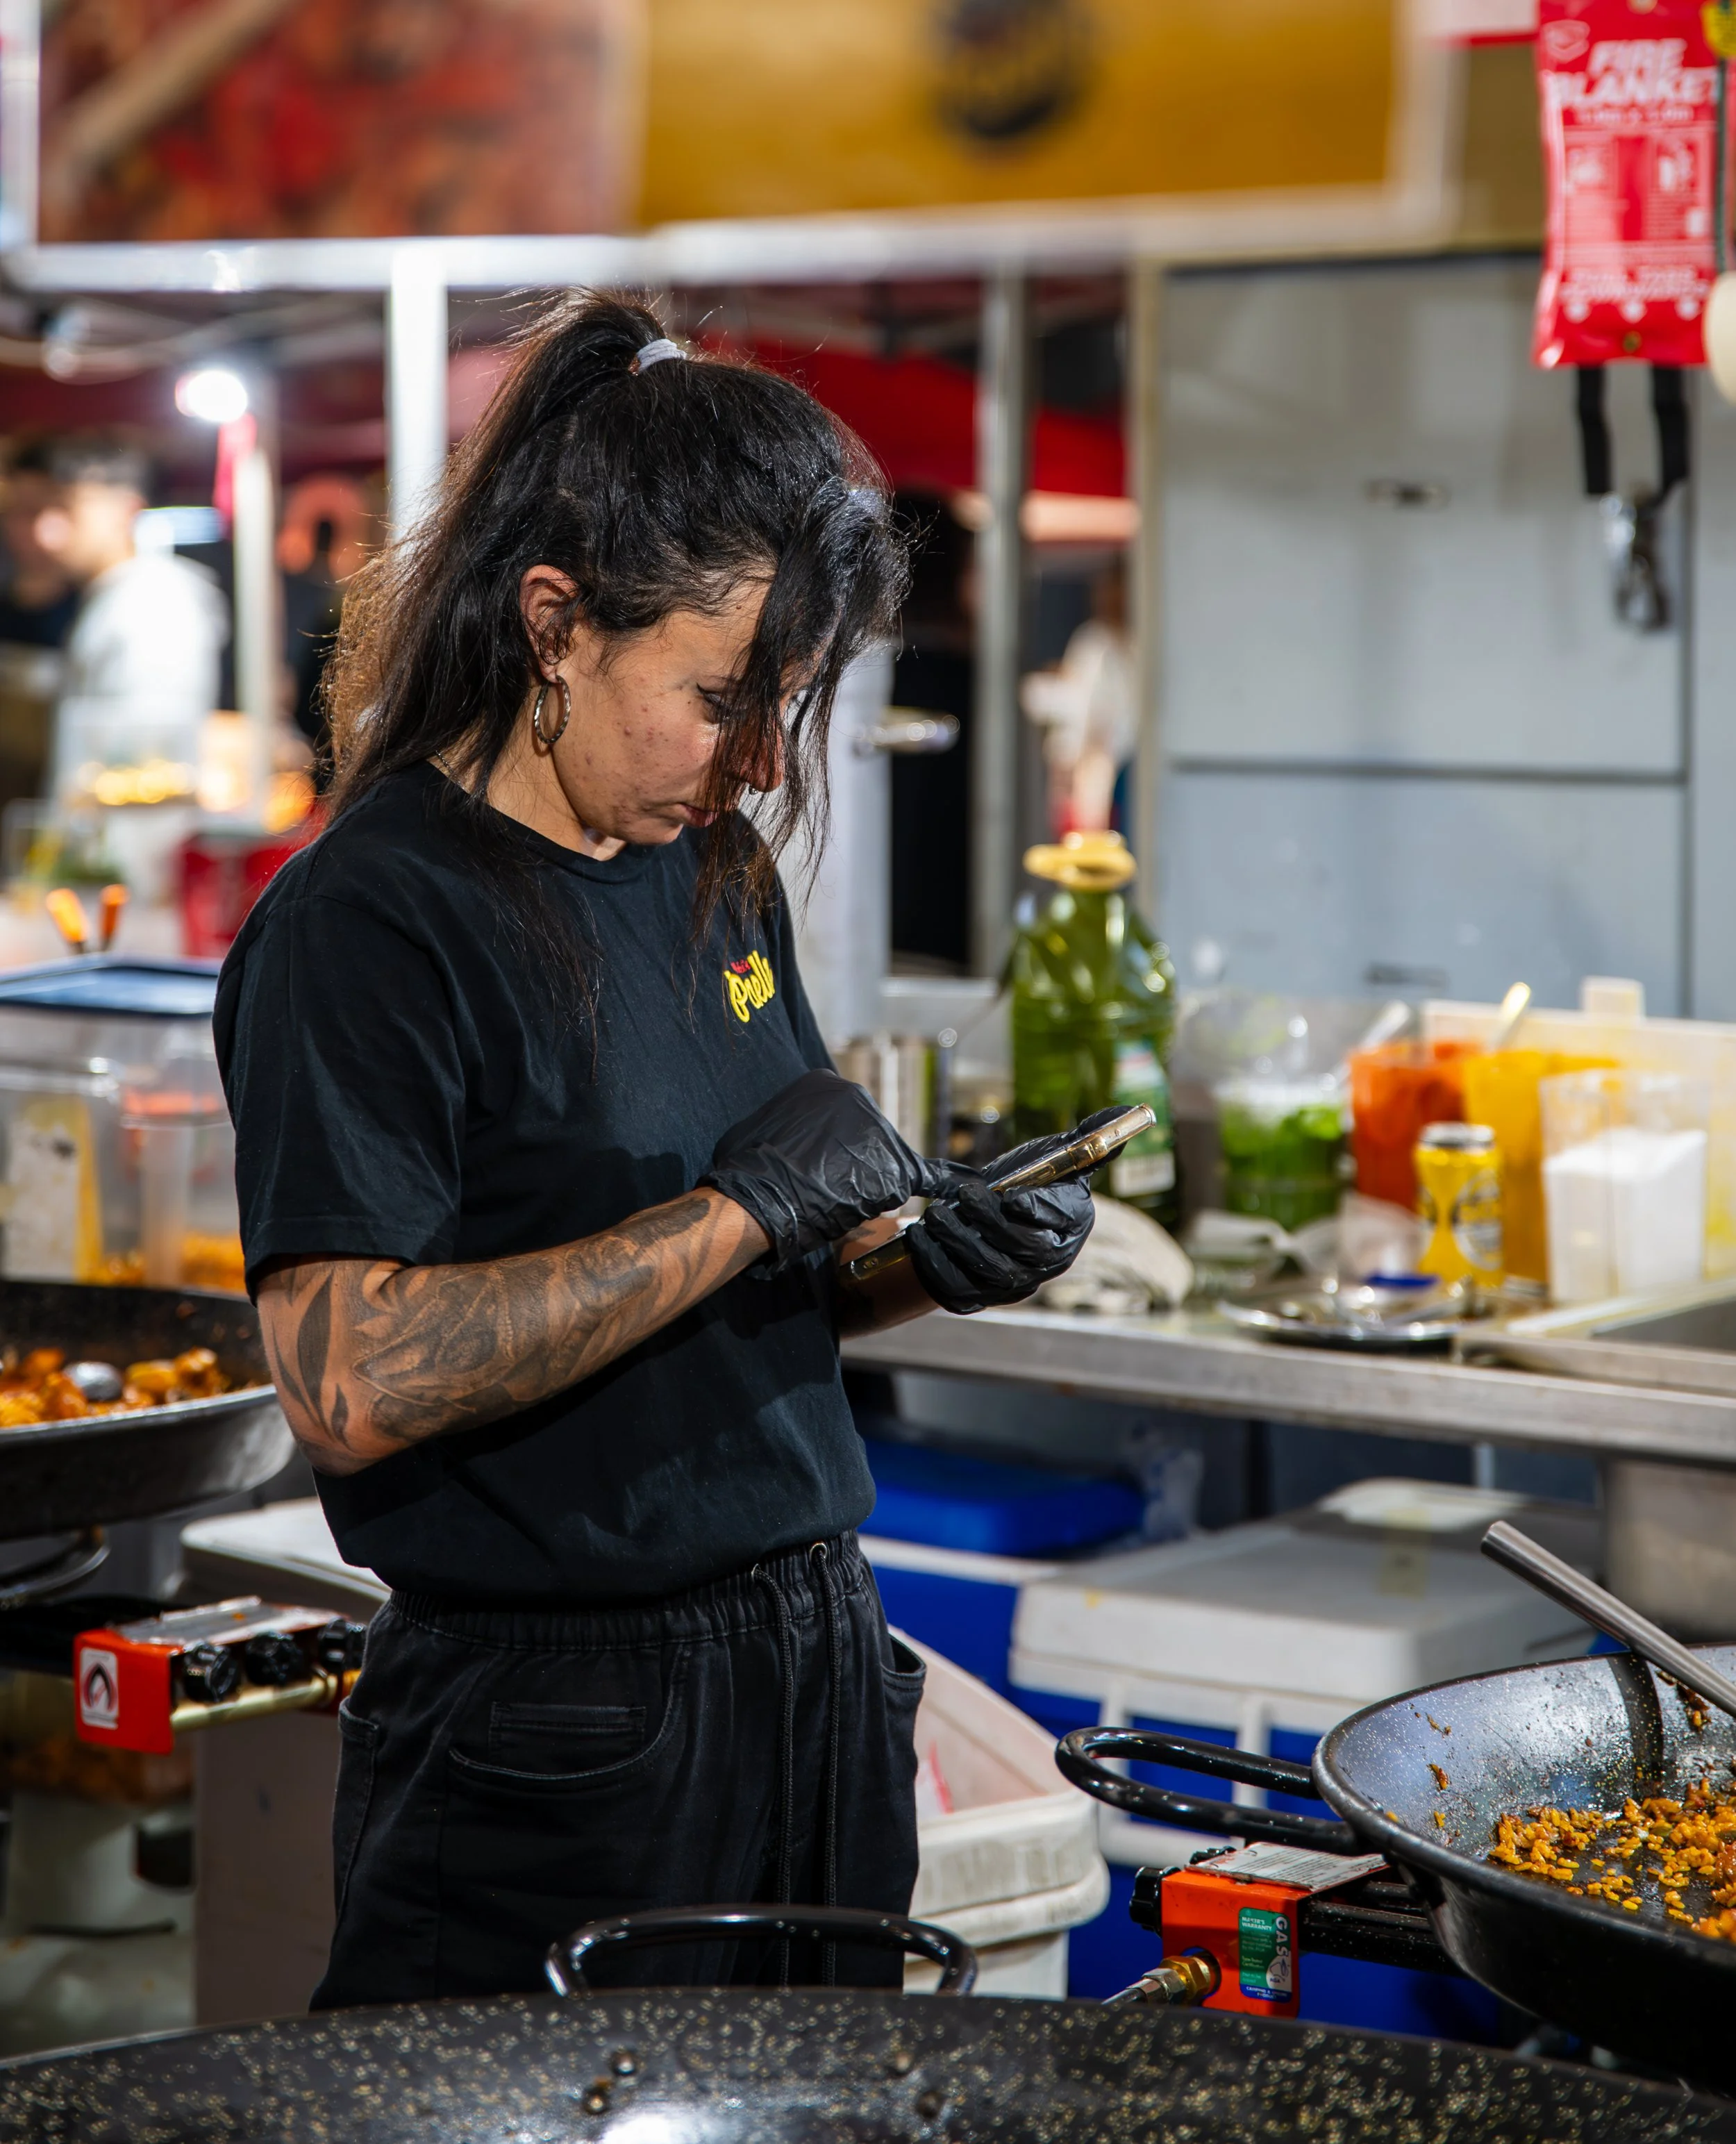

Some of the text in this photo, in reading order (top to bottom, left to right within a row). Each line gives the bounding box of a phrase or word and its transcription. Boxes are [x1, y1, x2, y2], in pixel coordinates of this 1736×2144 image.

[1587, 38, 1687, 78] FIRE
[1242, 1922, 1271, 1931] WARRANTY
[1276, 1916, 1288, 1956] GAS
